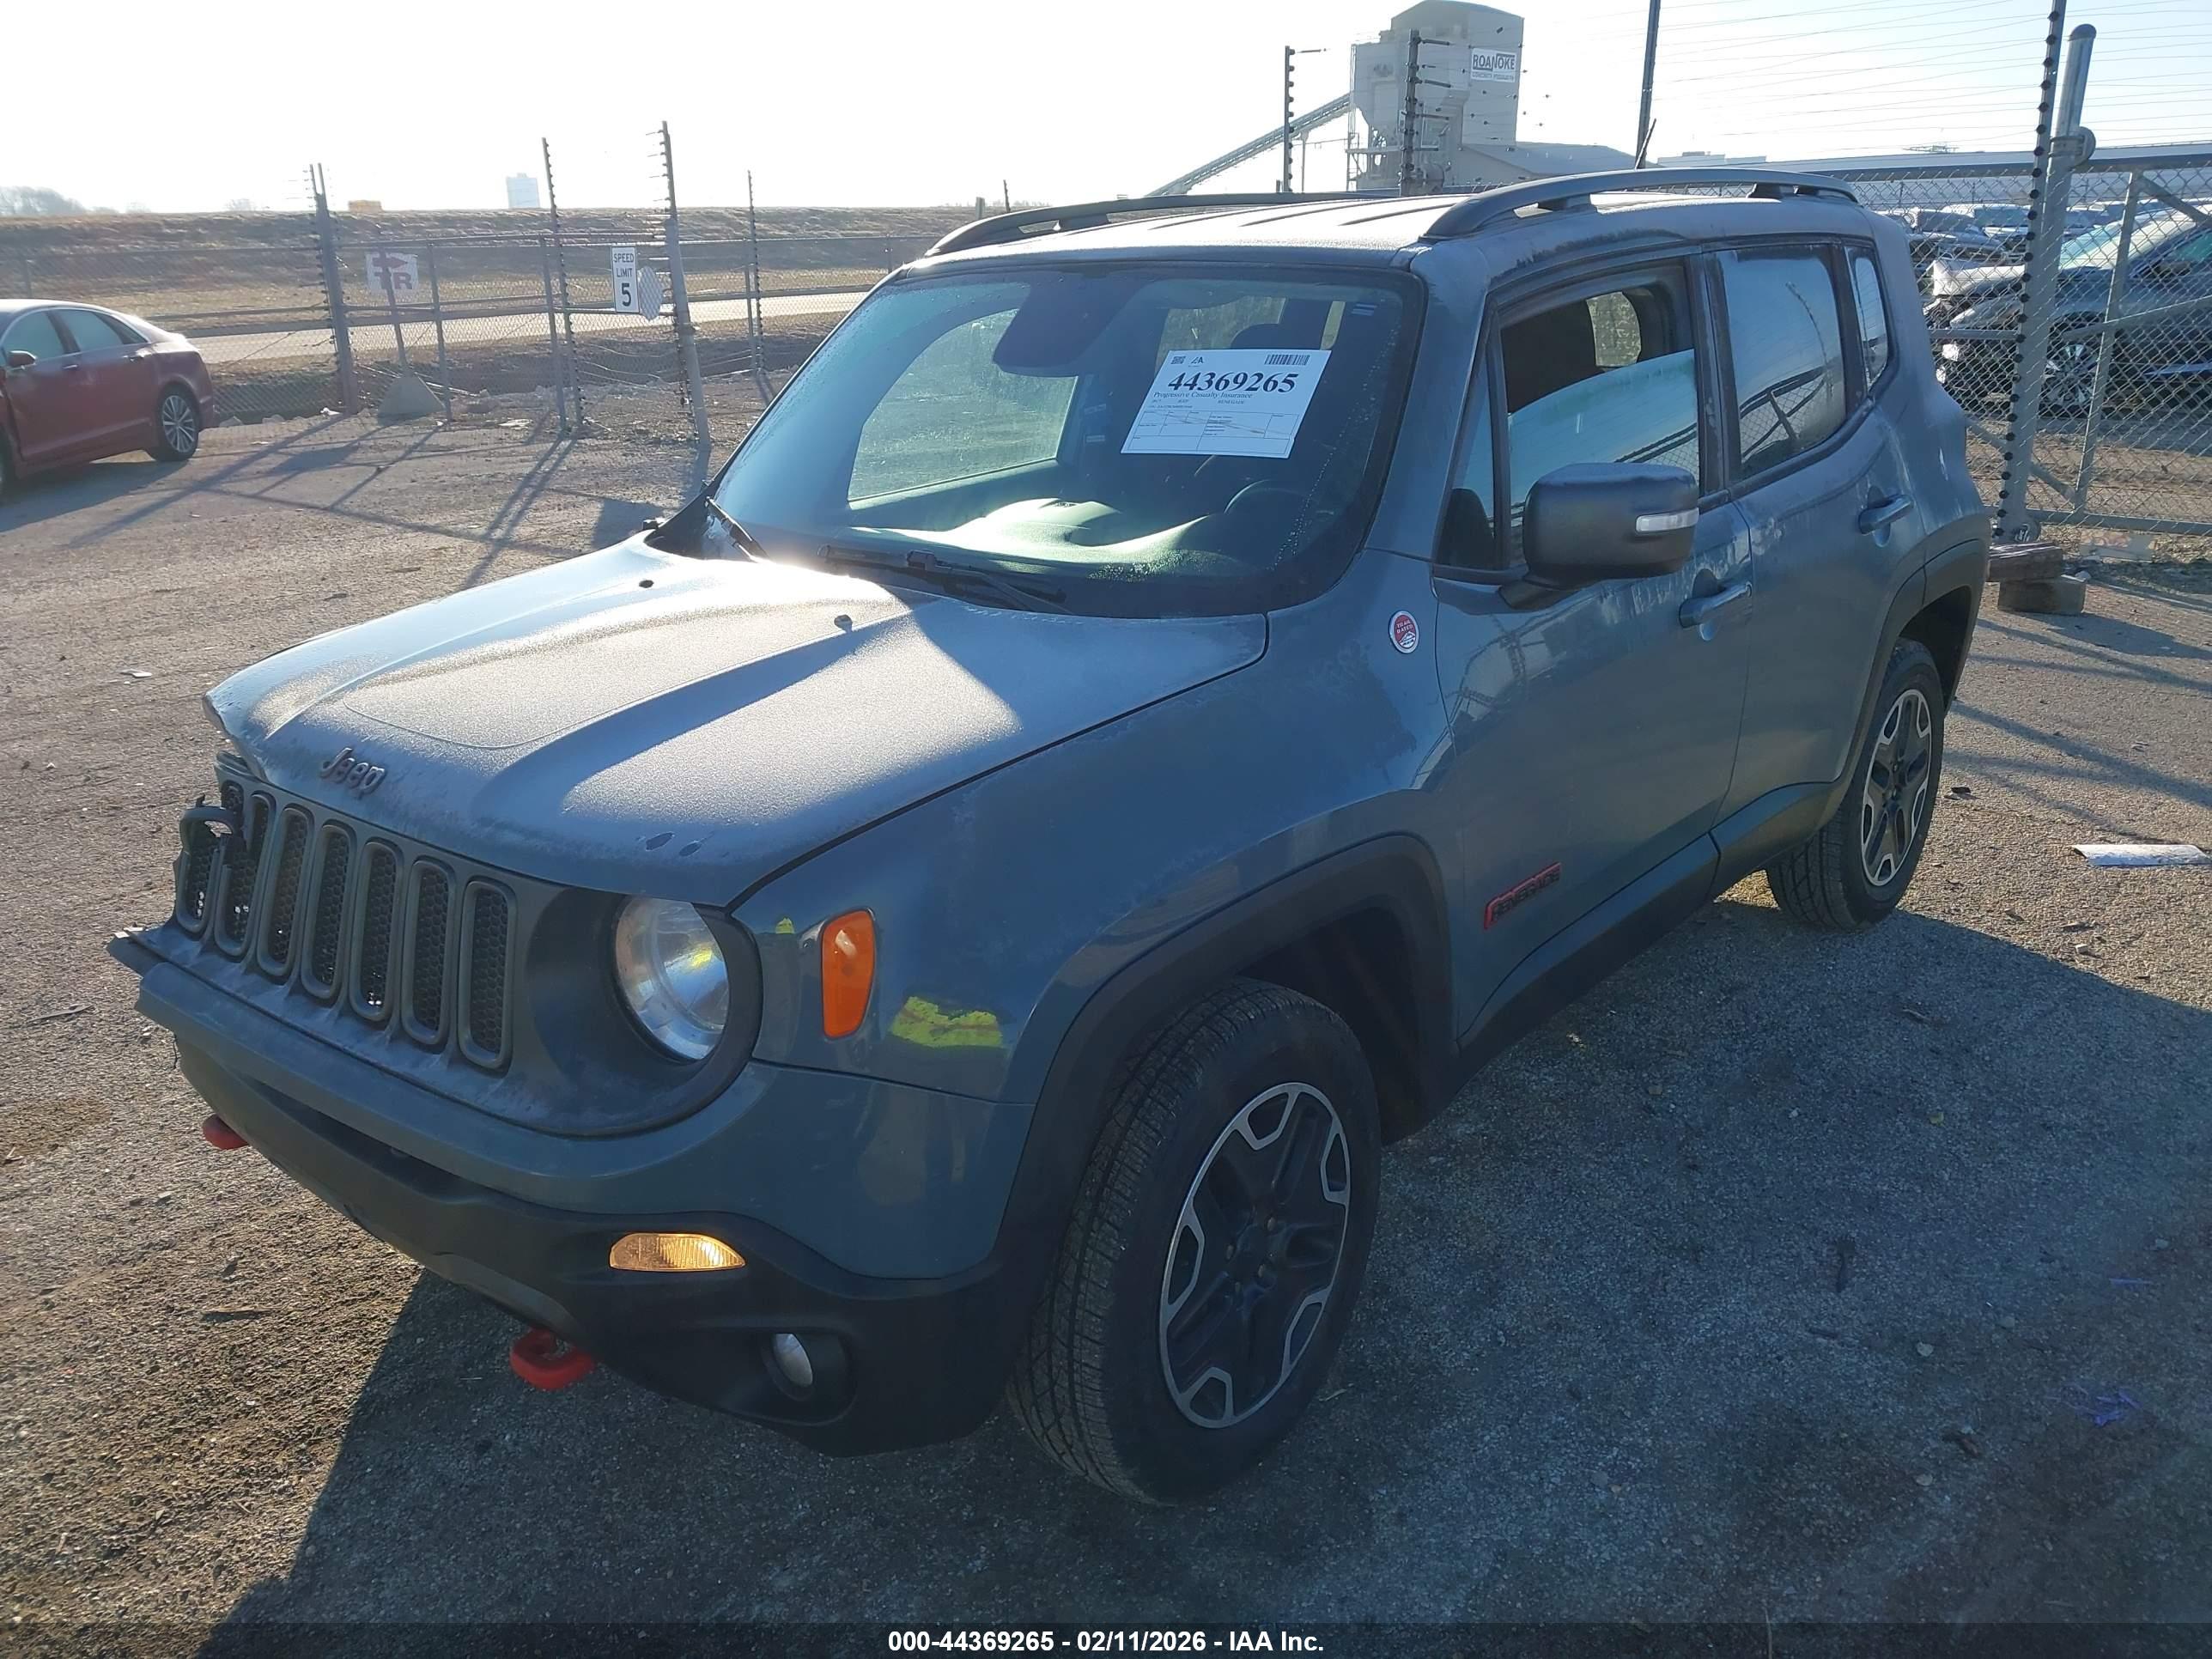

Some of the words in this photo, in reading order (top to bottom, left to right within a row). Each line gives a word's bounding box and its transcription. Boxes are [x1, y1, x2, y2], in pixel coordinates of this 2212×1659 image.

[1473, 53, 1515, 71] ROANOKE
[613, 252, 635, 263] SPEED
[616, 267, 633, 277] LIMIT
[621, 282, 632, 307] 5
[1168, 372, 1299, 393] 44369265
[1153, 391, 1190, 399] Progressive
[320, 746, 386, 799] Jeep
